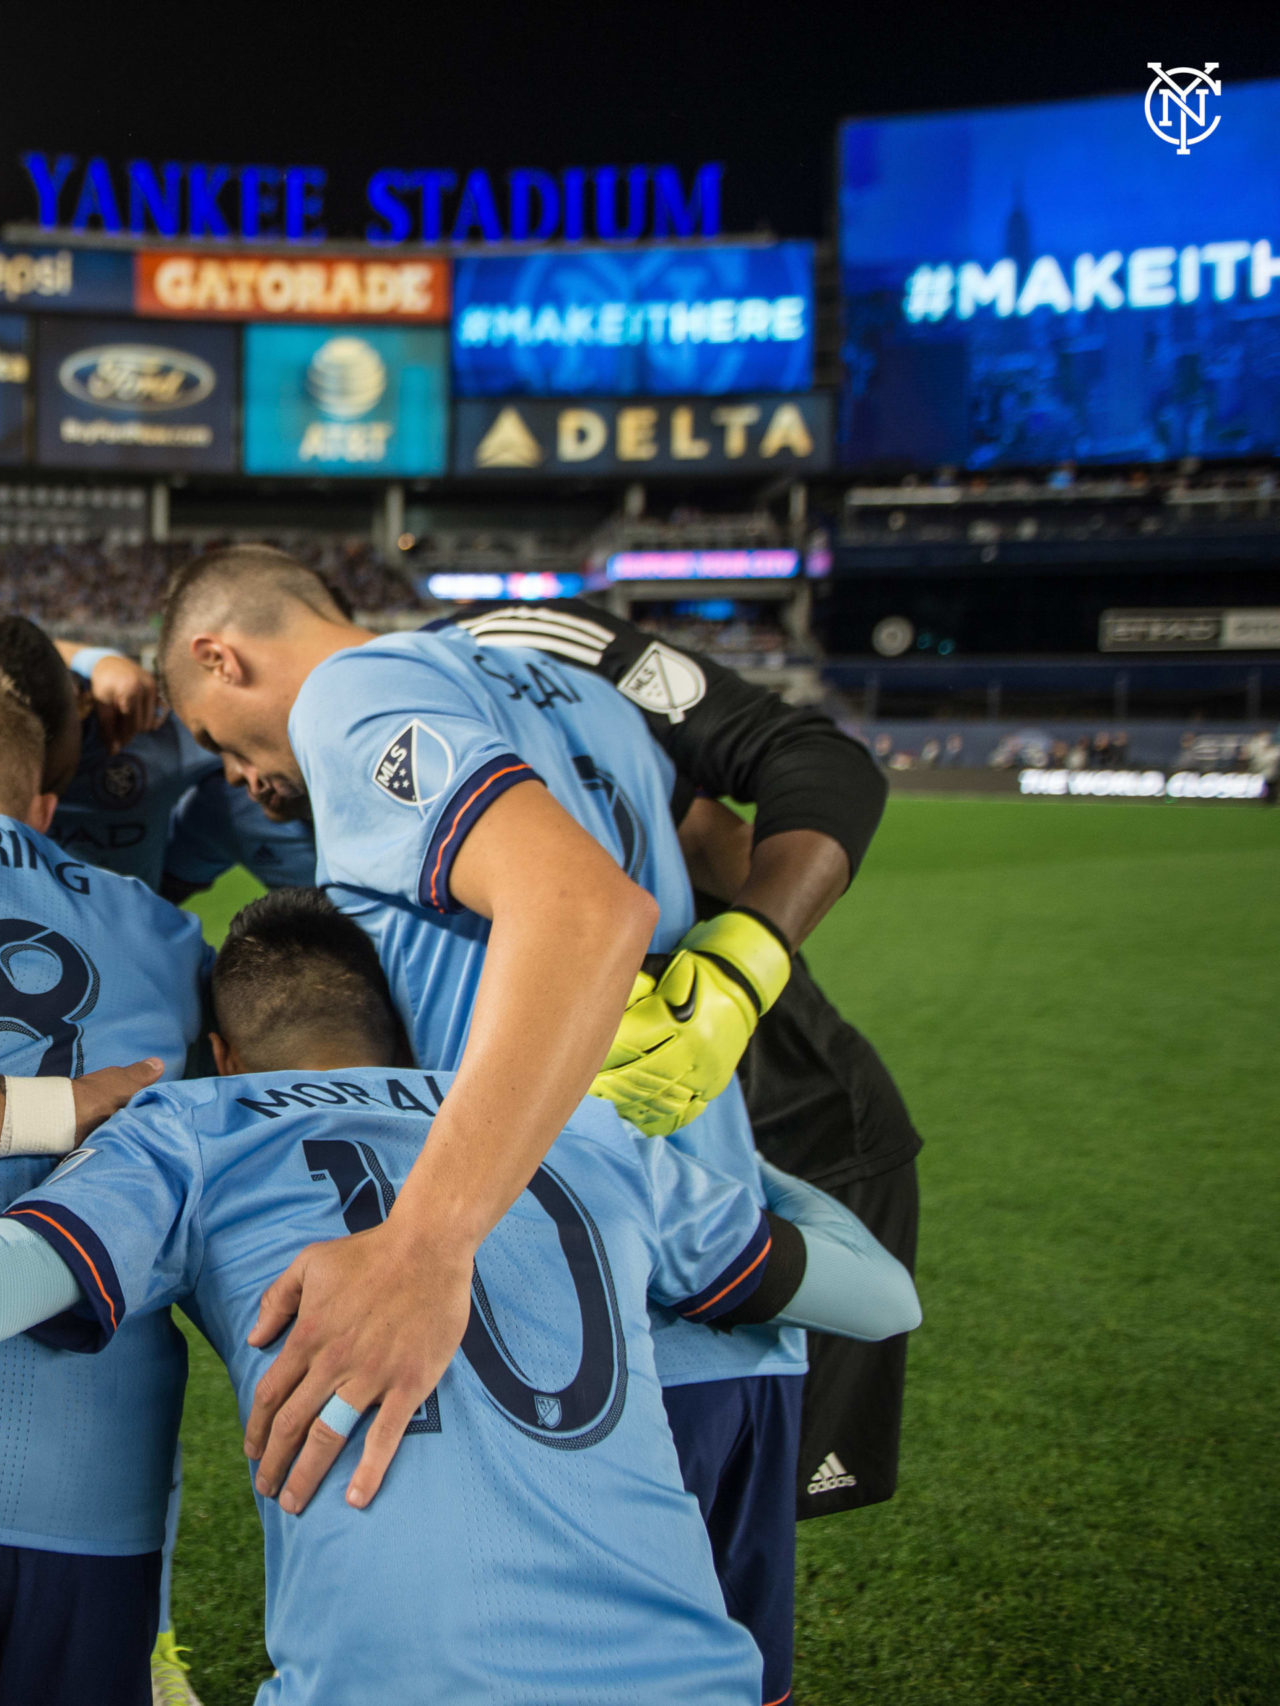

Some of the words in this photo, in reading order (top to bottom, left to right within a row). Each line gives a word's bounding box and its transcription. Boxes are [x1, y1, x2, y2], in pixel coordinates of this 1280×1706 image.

[23, 152, 326, 240] YANKEE
[365, 162, 723, 247] STADIUM
[154, 257, 433, 314] GATORADE
[458, 297, 805, 348] #MAKEITHERE
[86, 354, 186, 401] Ford
[298, 421, 393, 462] AT&T
[556, 403, 813, 462] DELTA
[377, 744, 408, 787] MLS
[807, 1475, 856, 1495] adidas
